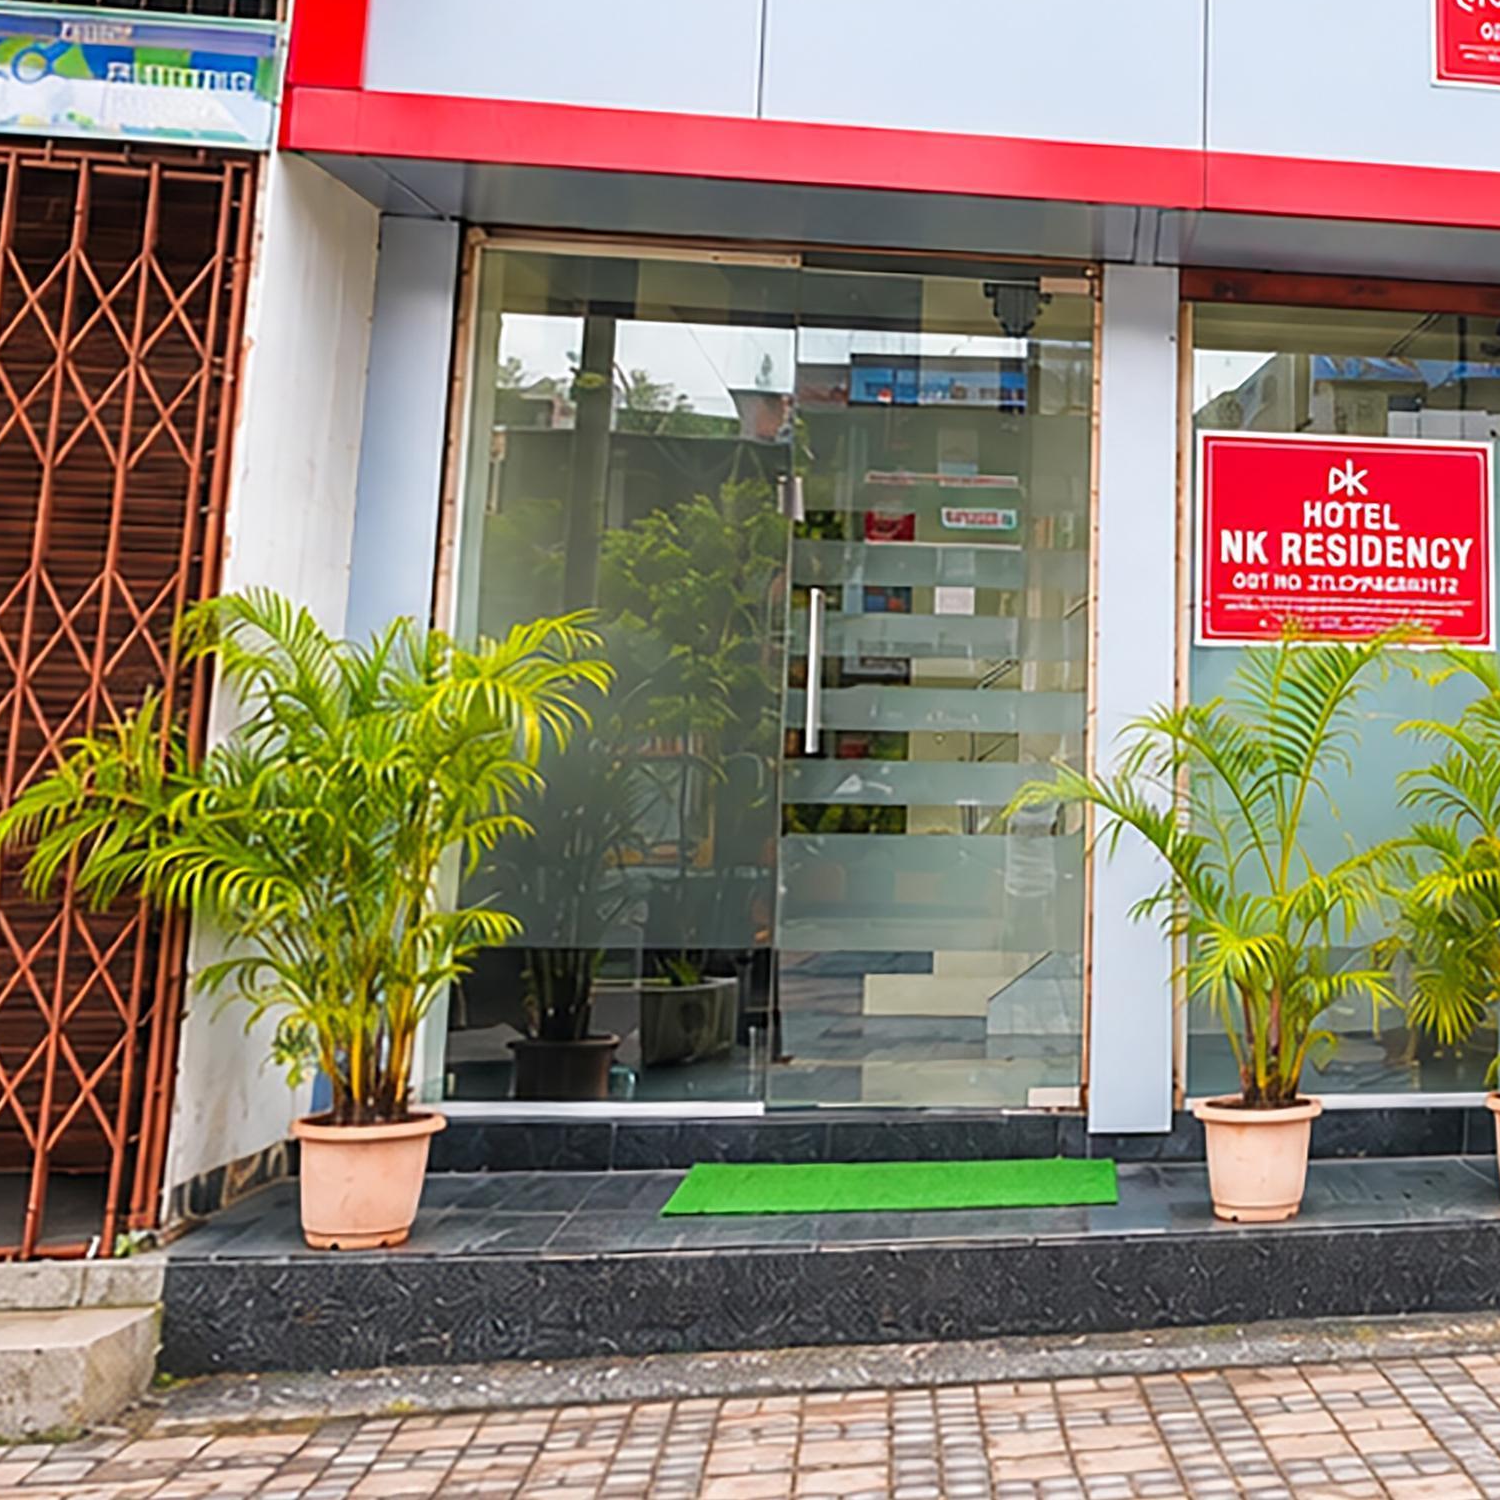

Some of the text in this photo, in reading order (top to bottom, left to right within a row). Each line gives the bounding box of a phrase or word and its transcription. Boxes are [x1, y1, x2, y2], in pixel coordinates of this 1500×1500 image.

[1303, 500, 1399, 531] HOTEL
[1220, 529, 1473, 570] NK RESIDENCY
